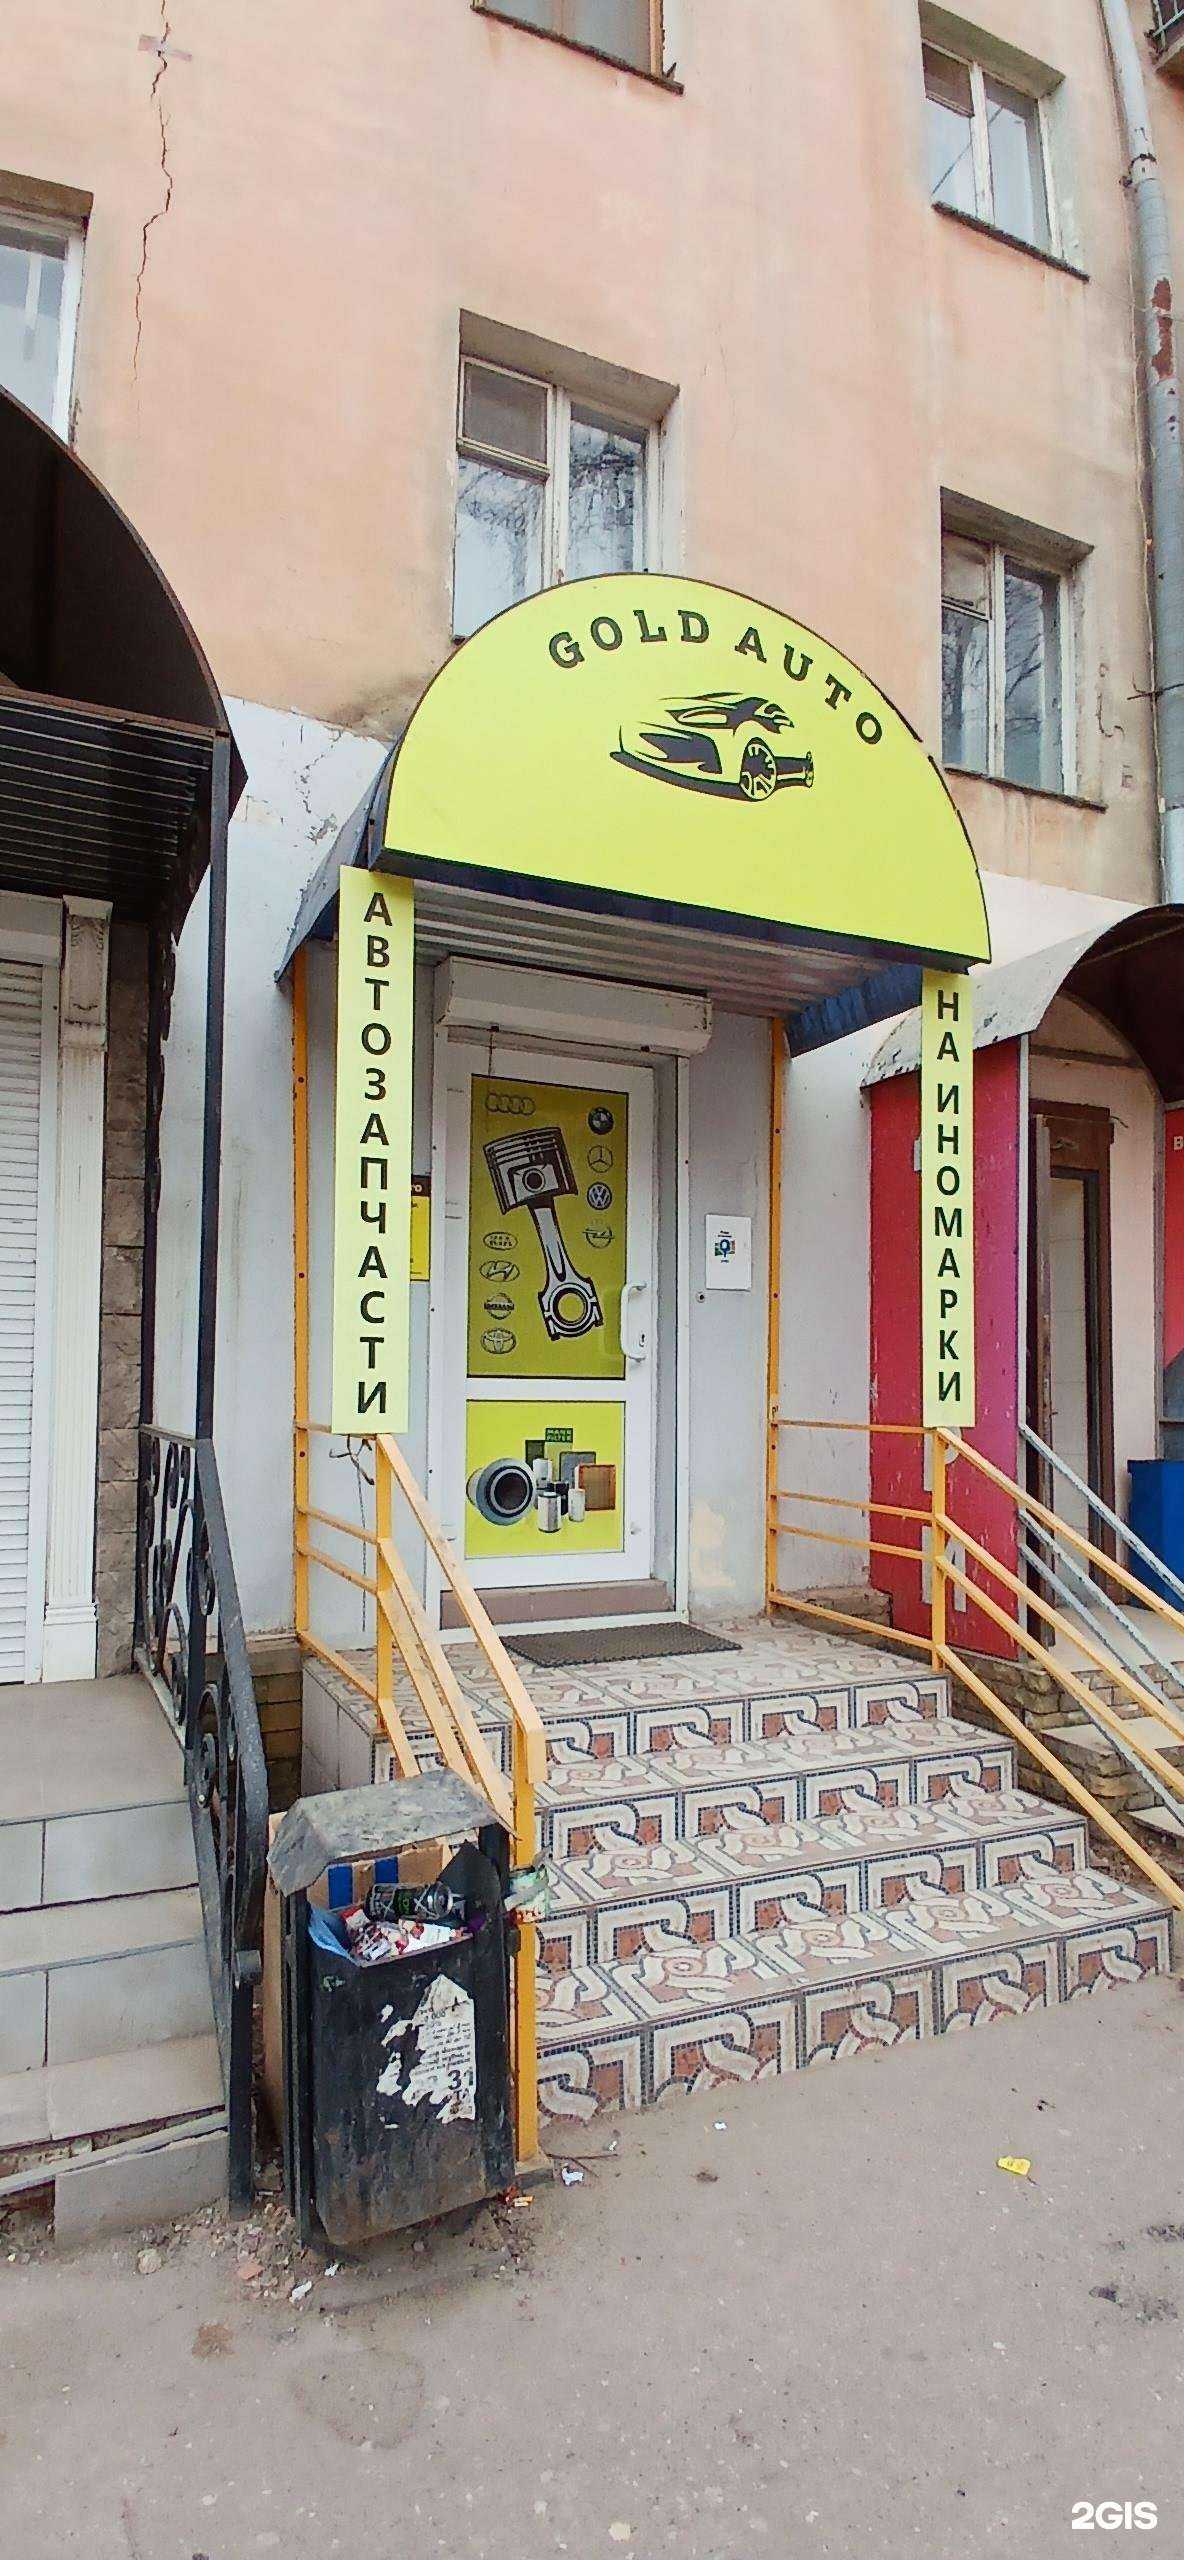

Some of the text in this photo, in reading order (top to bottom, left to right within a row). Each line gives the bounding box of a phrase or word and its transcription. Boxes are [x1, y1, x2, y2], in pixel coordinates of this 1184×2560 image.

[548, 609, 884, 745] GOLD AUTO
[936, 989, 961, 1063] НА
[357, 891, 393, 1414] АВТОЗАПЧАСТИ
[934, 1083, 964, 1402] ИНОМАРКИ
